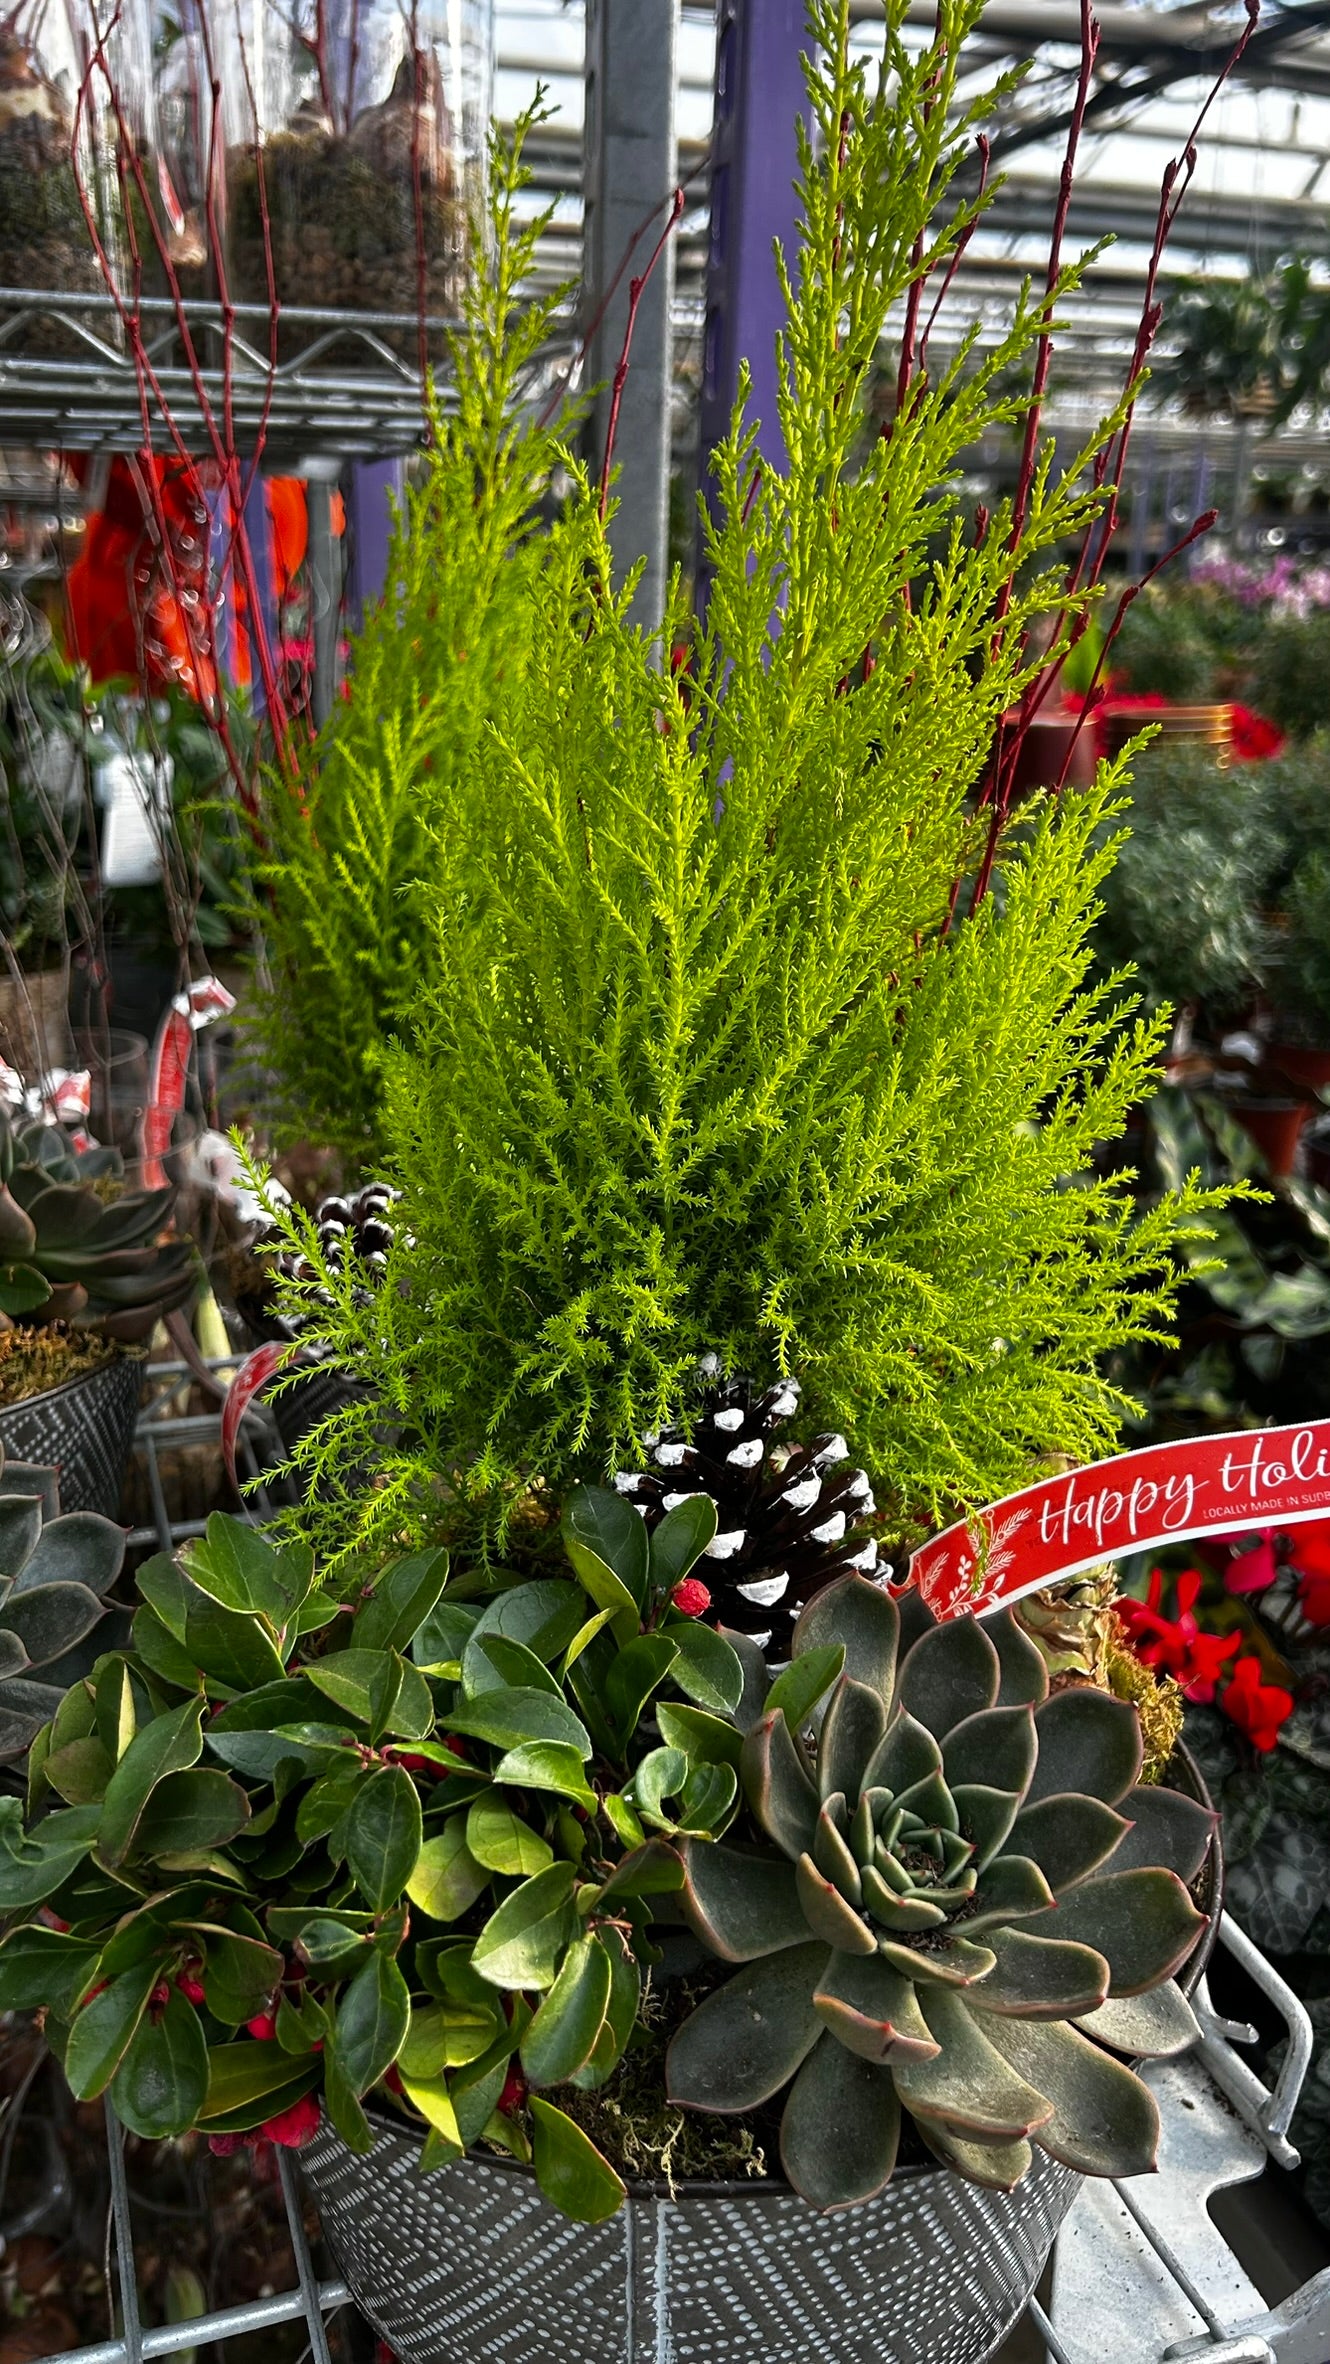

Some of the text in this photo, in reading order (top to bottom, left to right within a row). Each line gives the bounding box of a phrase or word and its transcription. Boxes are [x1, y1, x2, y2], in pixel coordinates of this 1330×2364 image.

[1037, 1474, 1209, 1546] Happy
[1203, 1503, 1248, 1519] LOCALLY
[1250, 1497, 1284, 1511] MADE
[1286, 1496, 1299, 1505] IN
